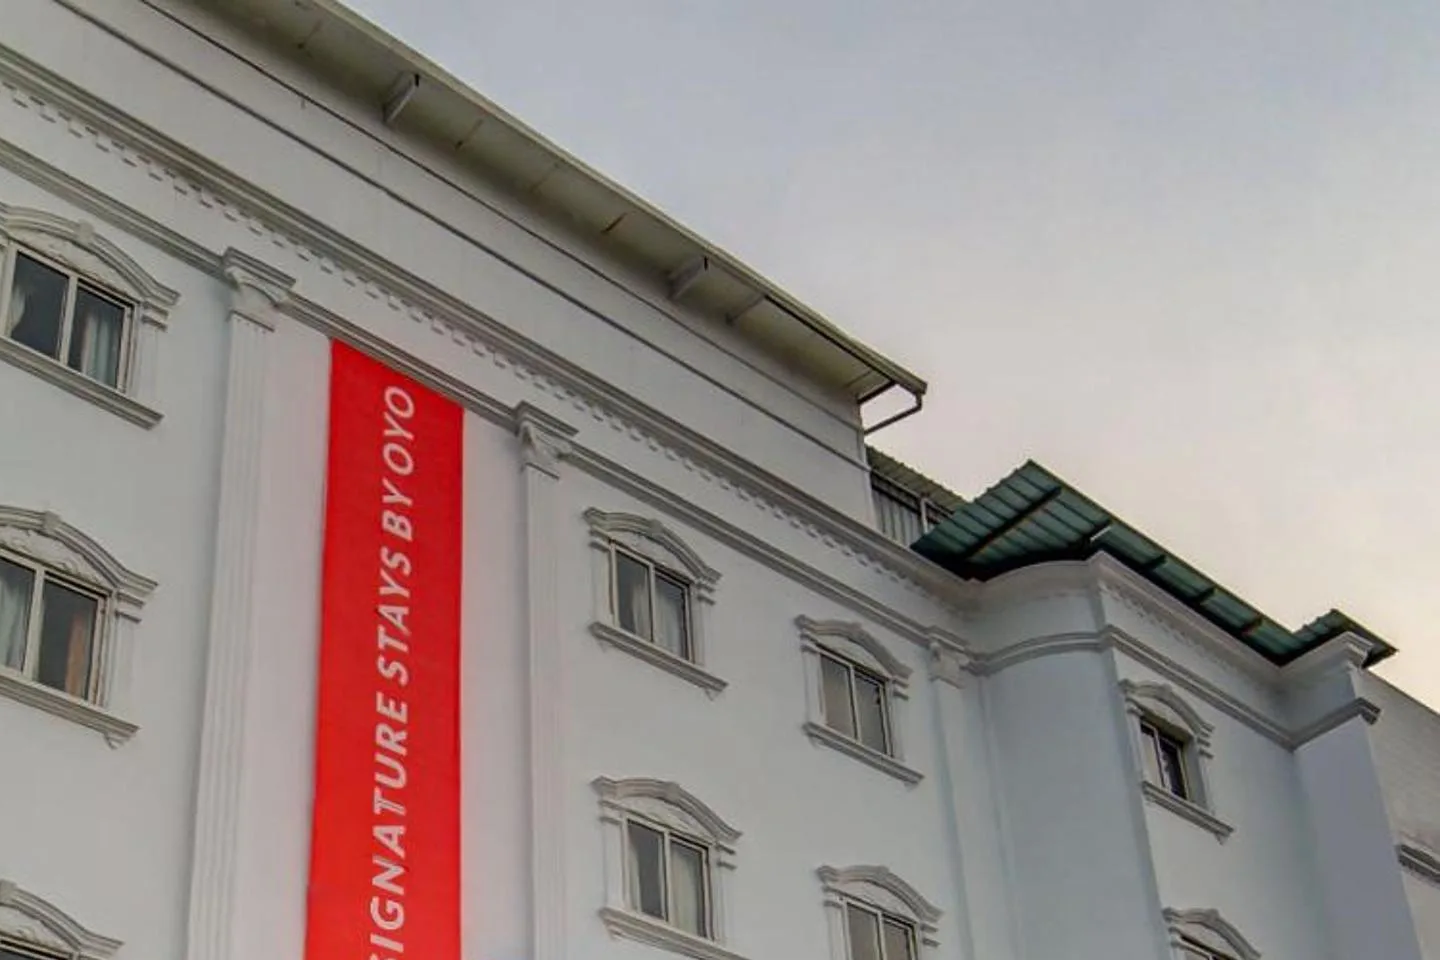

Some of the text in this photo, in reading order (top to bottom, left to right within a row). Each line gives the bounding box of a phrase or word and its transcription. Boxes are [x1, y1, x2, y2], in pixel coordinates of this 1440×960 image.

[382, 386, 415, 476] OYO
[381, 477, 414, 542] BY
[375, 546, 412, 687] STAYS
